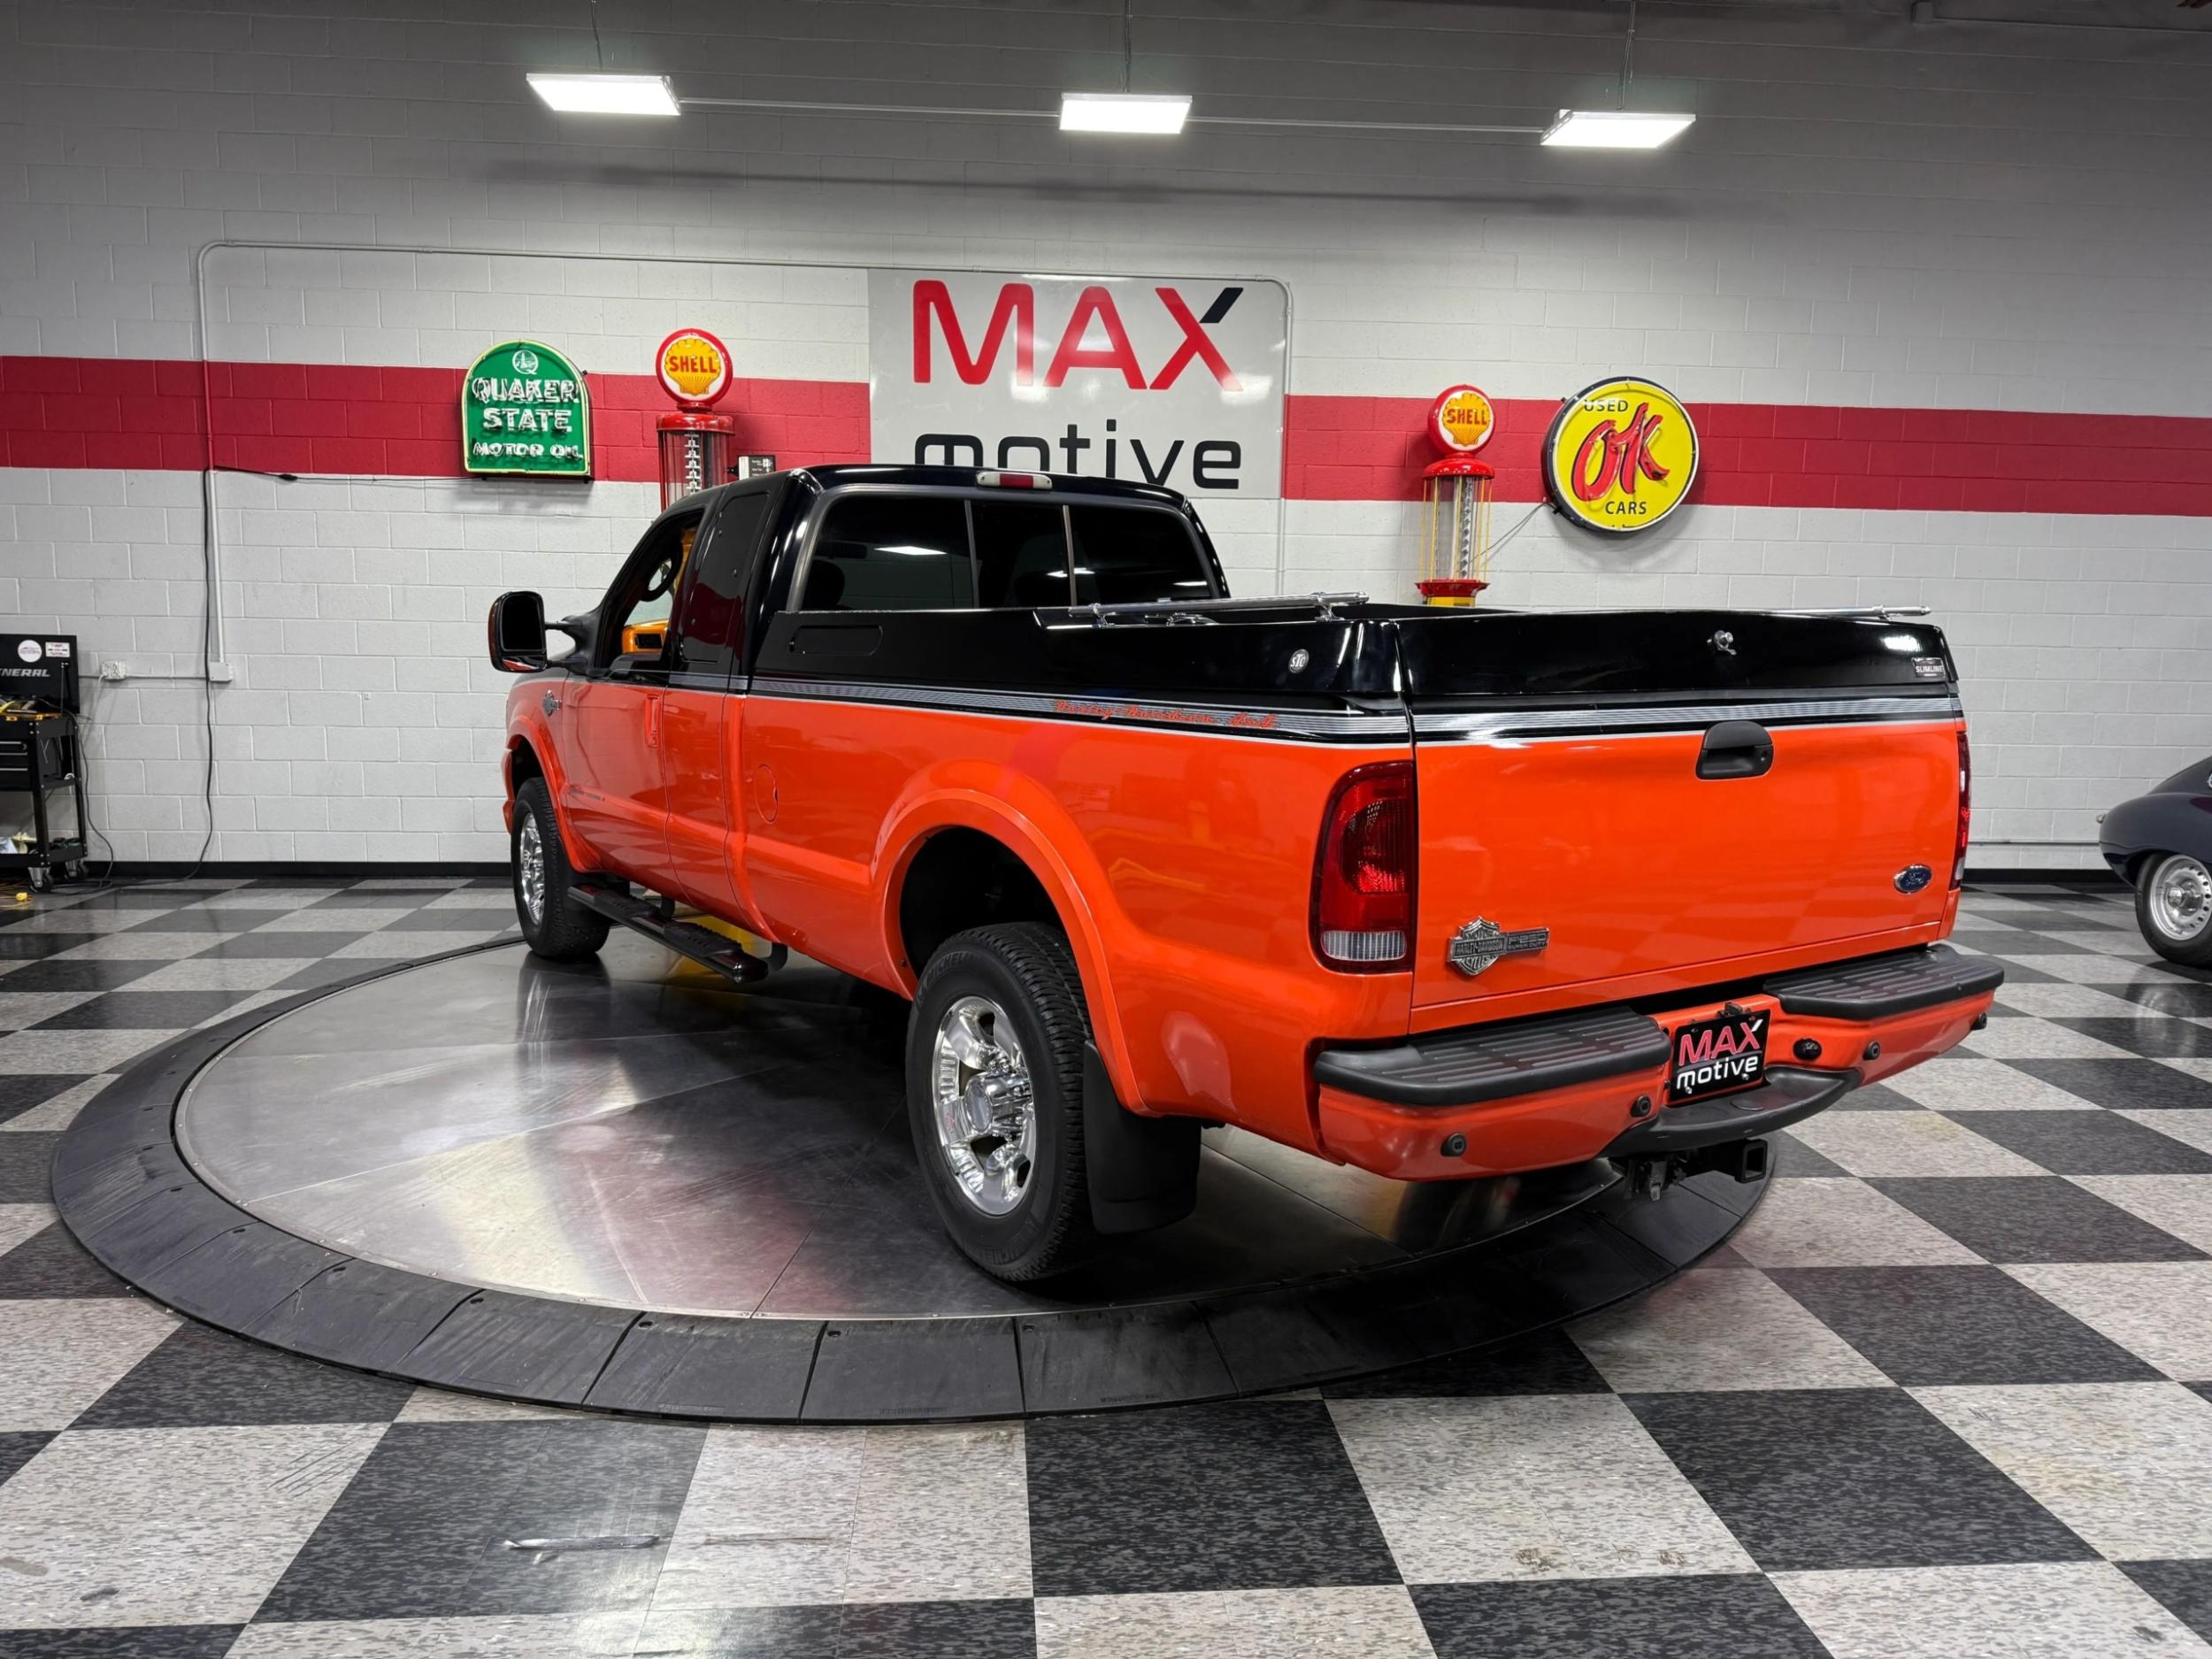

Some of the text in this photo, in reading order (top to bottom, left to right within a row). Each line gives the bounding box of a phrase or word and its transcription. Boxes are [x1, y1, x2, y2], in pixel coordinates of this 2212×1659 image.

[913, 280, 1244, 391] MAX
[669, 356, 718, 374] SHELL
[472, 378, 580, 403] QUAKER
[1447, 408, 1488, 426] SHELL
[1584, 399, 1629, 412] USED
[483, 408, 572, 432] STATE
[472, 442, 583, 459] MOTOR OIL
[915, 419, 1241, 489] motive
[1571, 403, 1671, 502] OK
[1605, 501, 1647, 515] CARS
[0, 668, 50, 677] NERAL
[1678, 1018, 1763, 1066] MAX
[1677, 1056, 1758, 1090] motive
